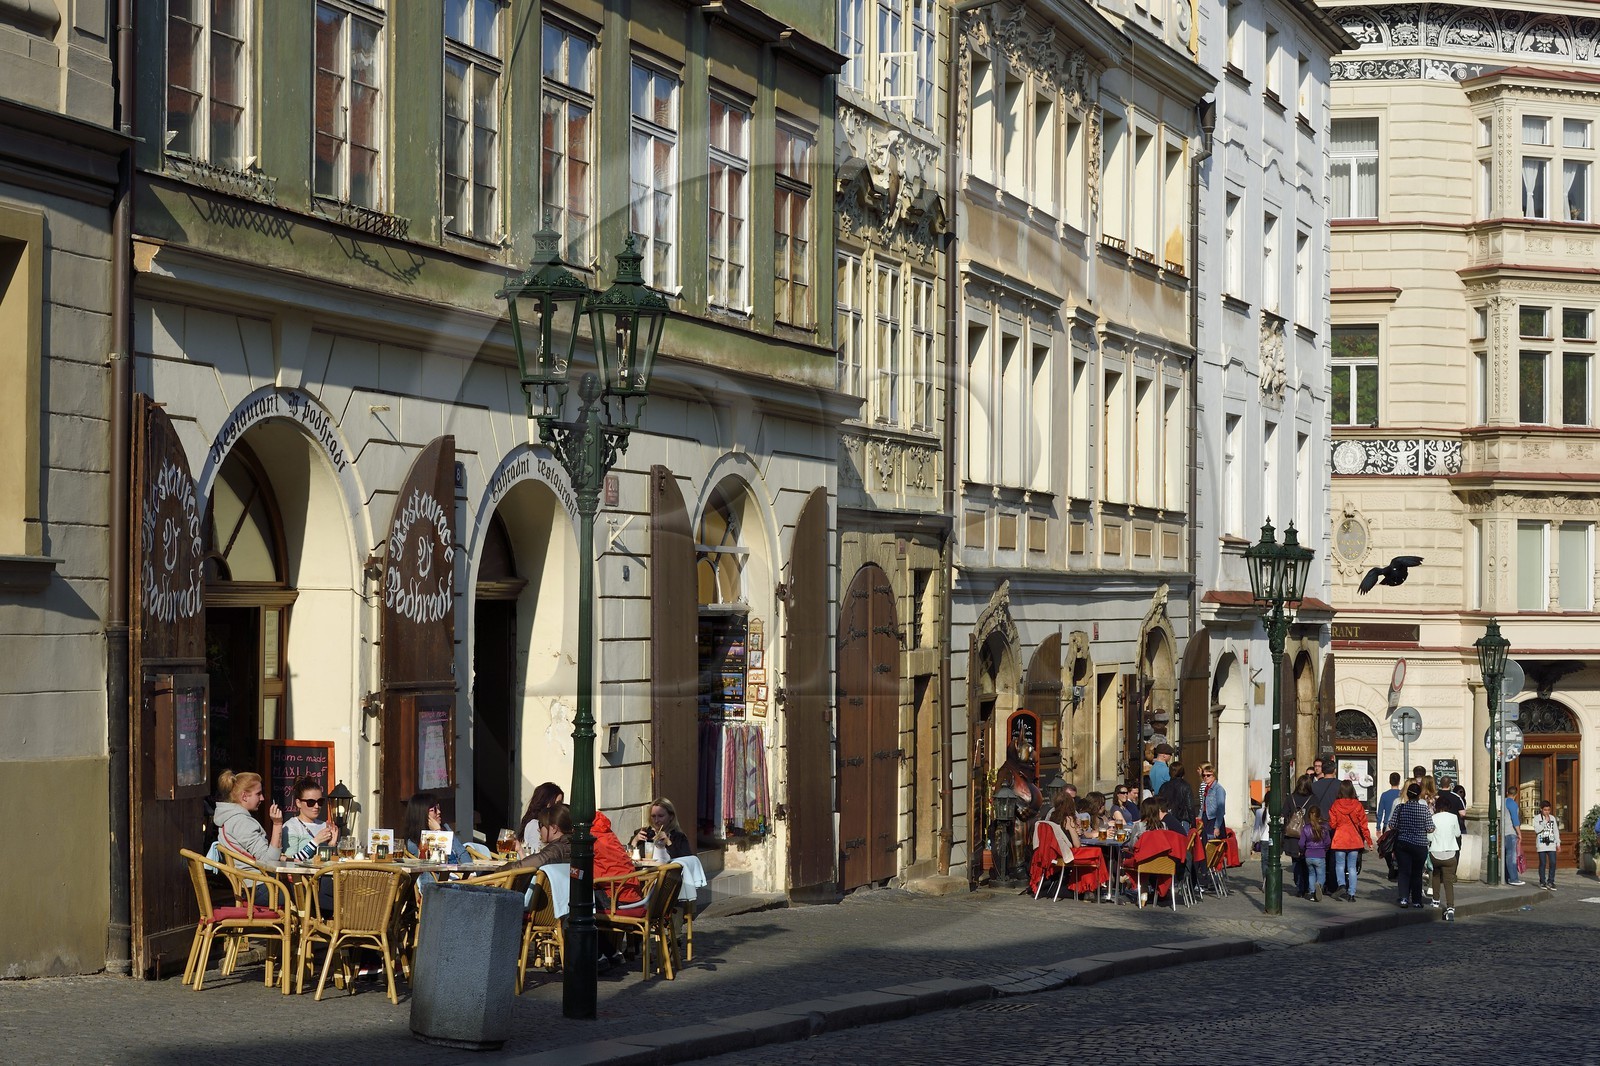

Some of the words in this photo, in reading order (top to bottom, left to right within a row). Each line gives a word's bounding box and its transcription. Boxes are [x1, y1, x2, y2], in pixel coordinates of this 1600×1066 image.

[211, 391, 280, 465] Restaurant
[455, 467, 461, 482] 8
[389, 486, 455, 563] Restaurace
[273, 749, 303, 762] Home
[305, 752, 327, 763] made
